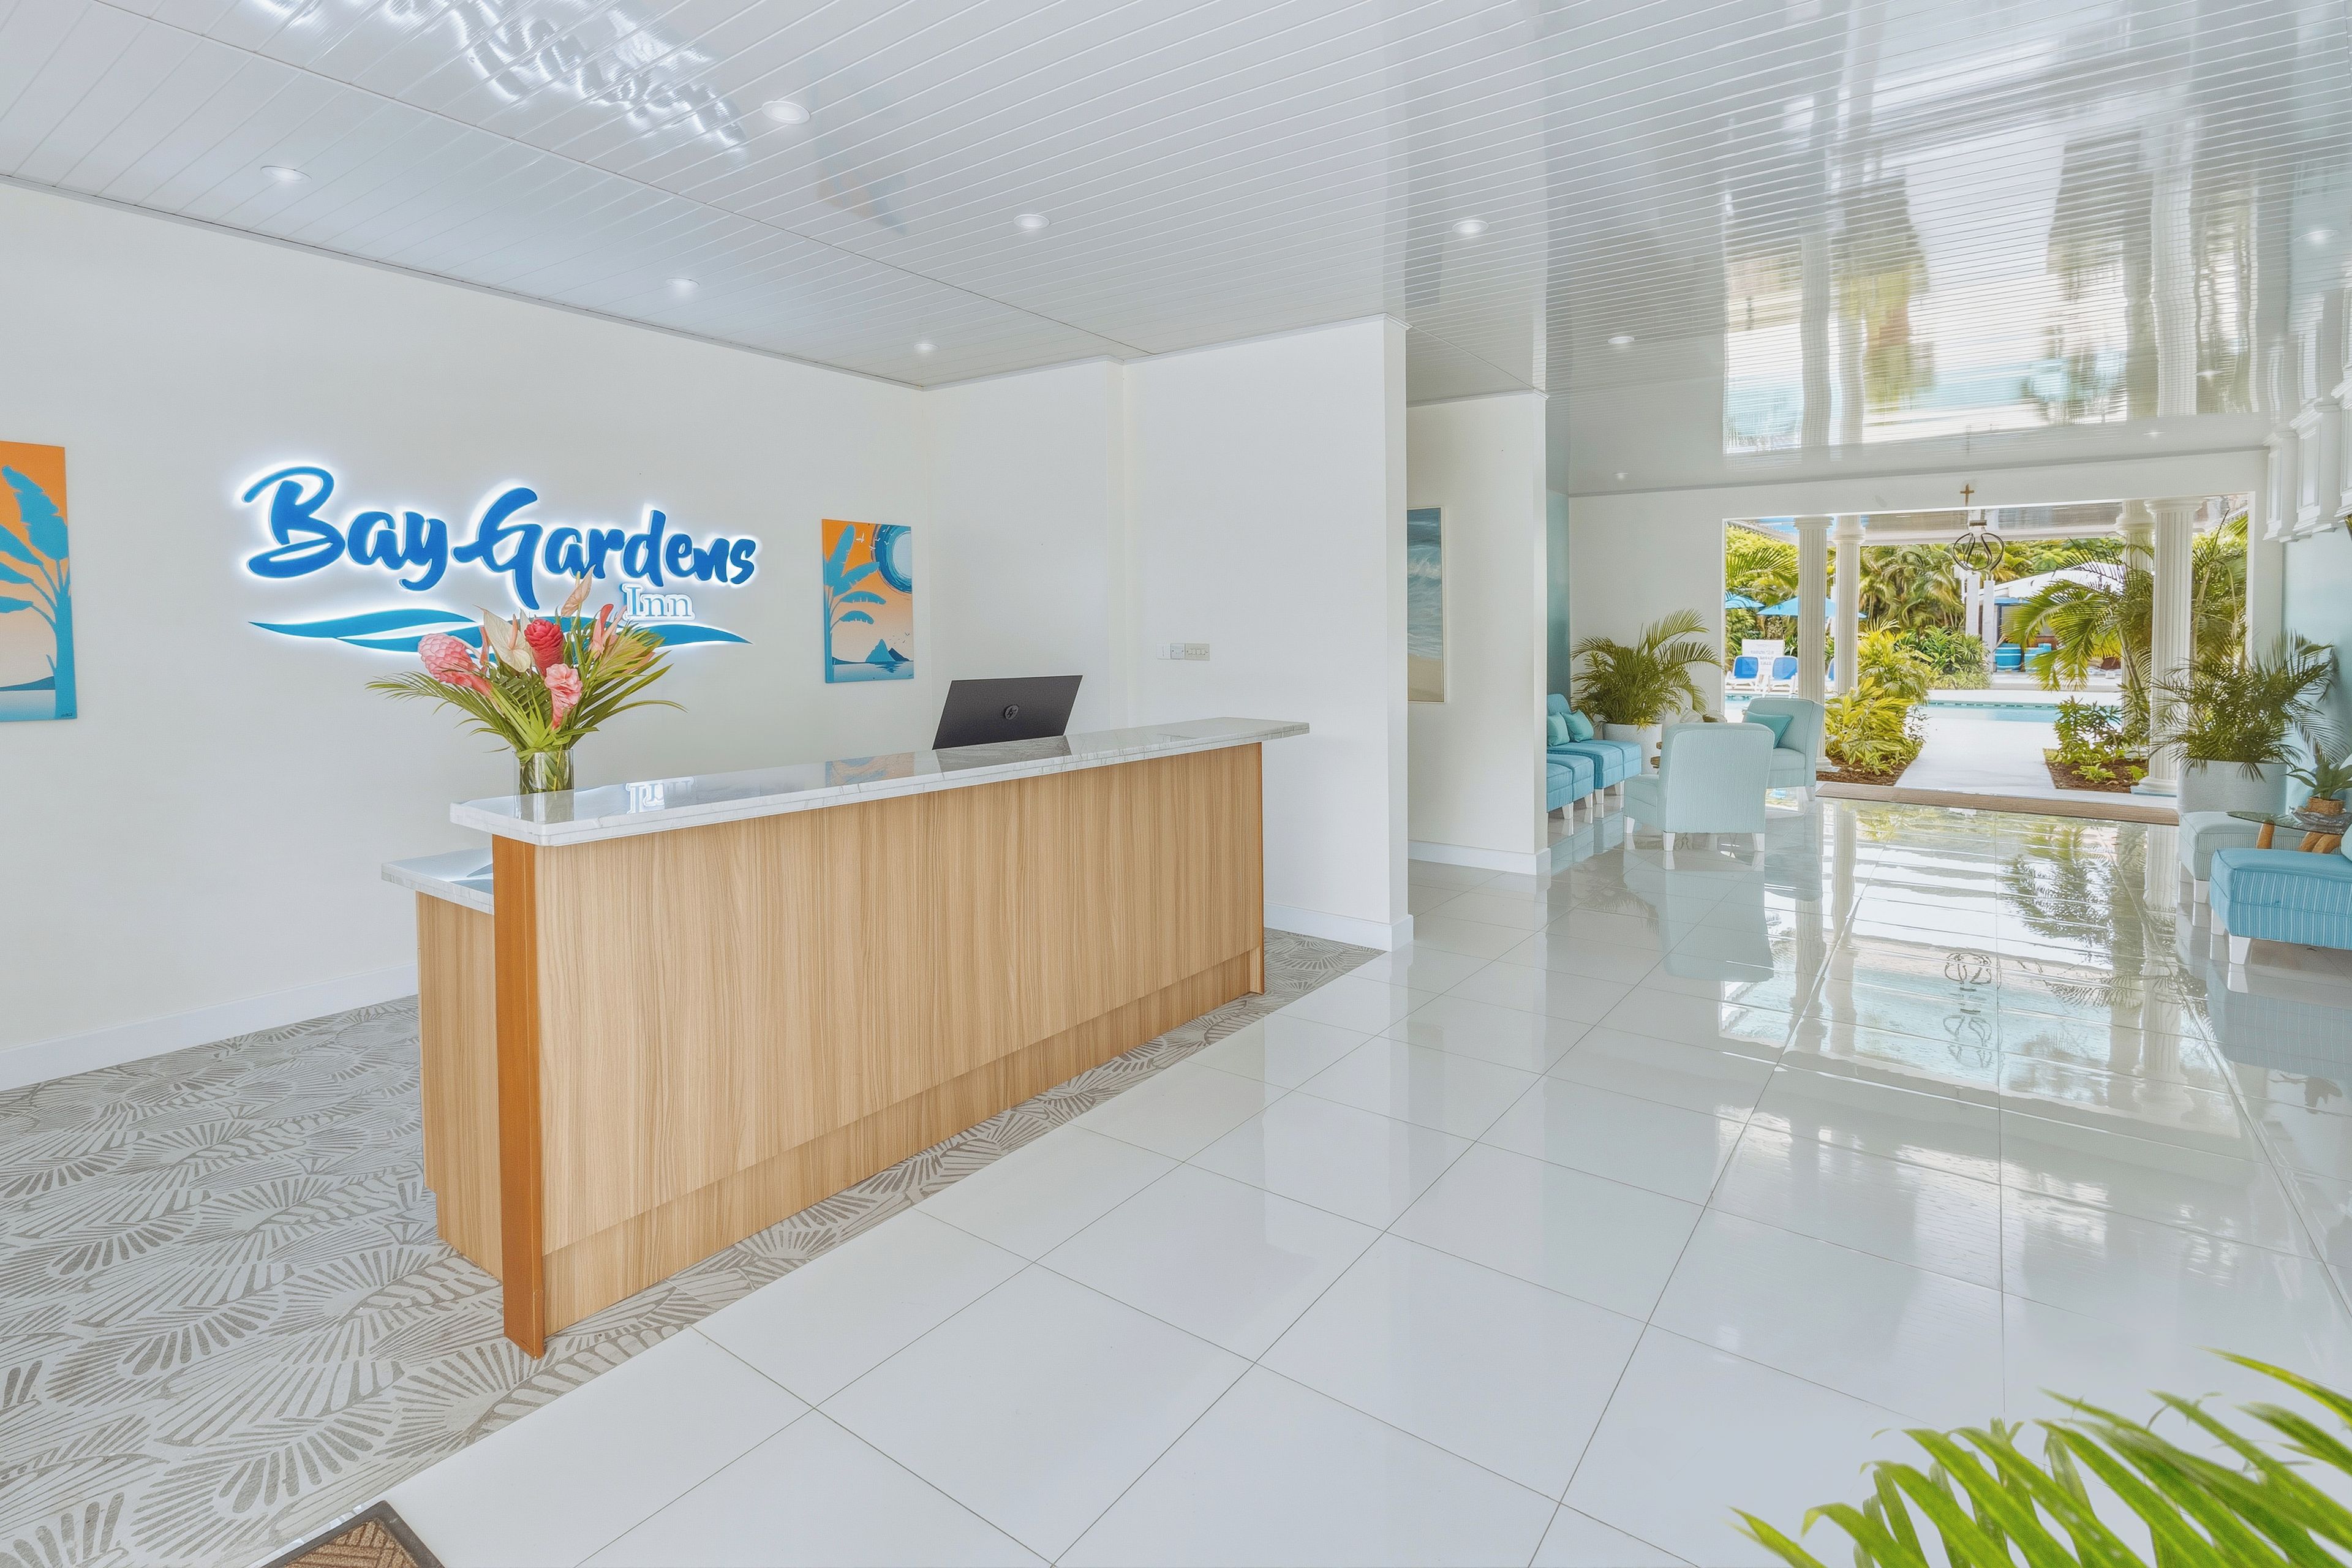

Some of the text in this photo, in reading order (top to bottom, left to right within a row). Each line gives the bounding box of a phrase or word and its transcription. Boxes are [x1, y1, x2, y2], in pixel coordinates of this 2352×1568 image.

[242, 466, 757, 611] Bay Gardens
[622, 584, 695, 620] Inn
